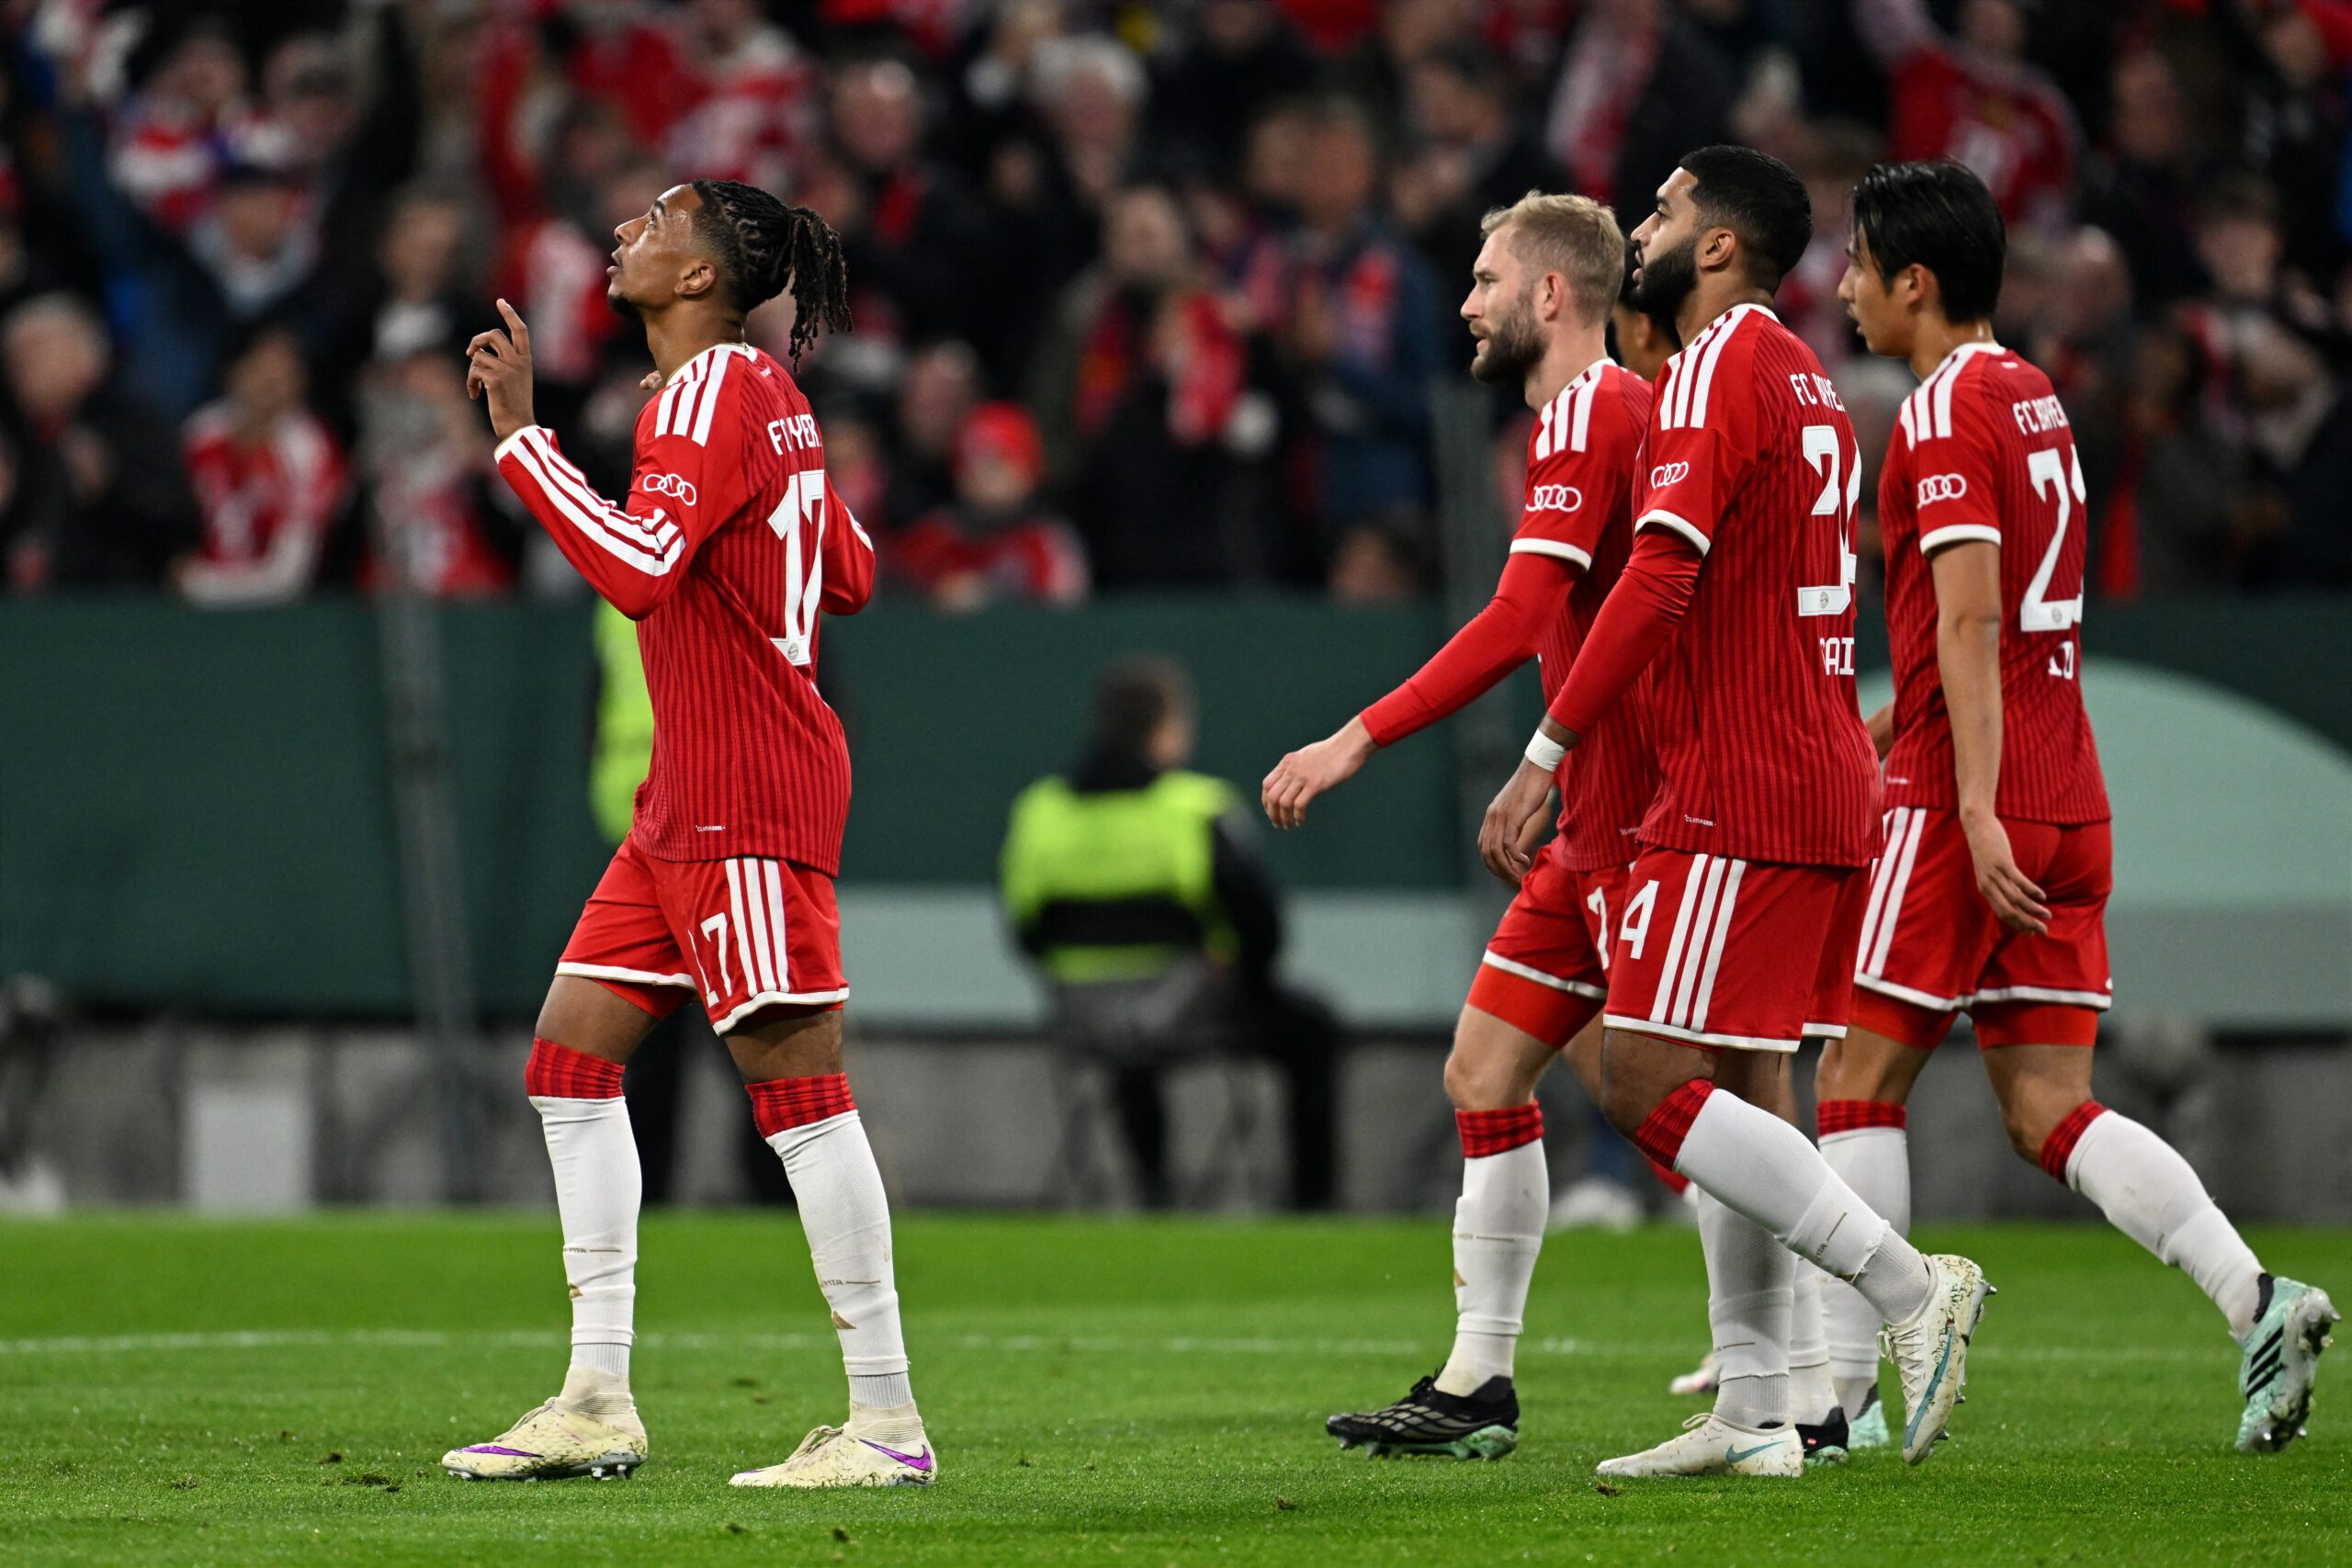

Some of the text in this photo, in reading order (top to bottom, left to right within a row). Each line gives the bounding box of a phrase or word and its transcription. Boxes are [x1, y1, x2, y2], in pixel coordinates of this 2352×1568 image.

[1790, 373, 1817, 406] FC
[2012, 400, 2039, 435] FC
[766, 469, 825, 667] 17
